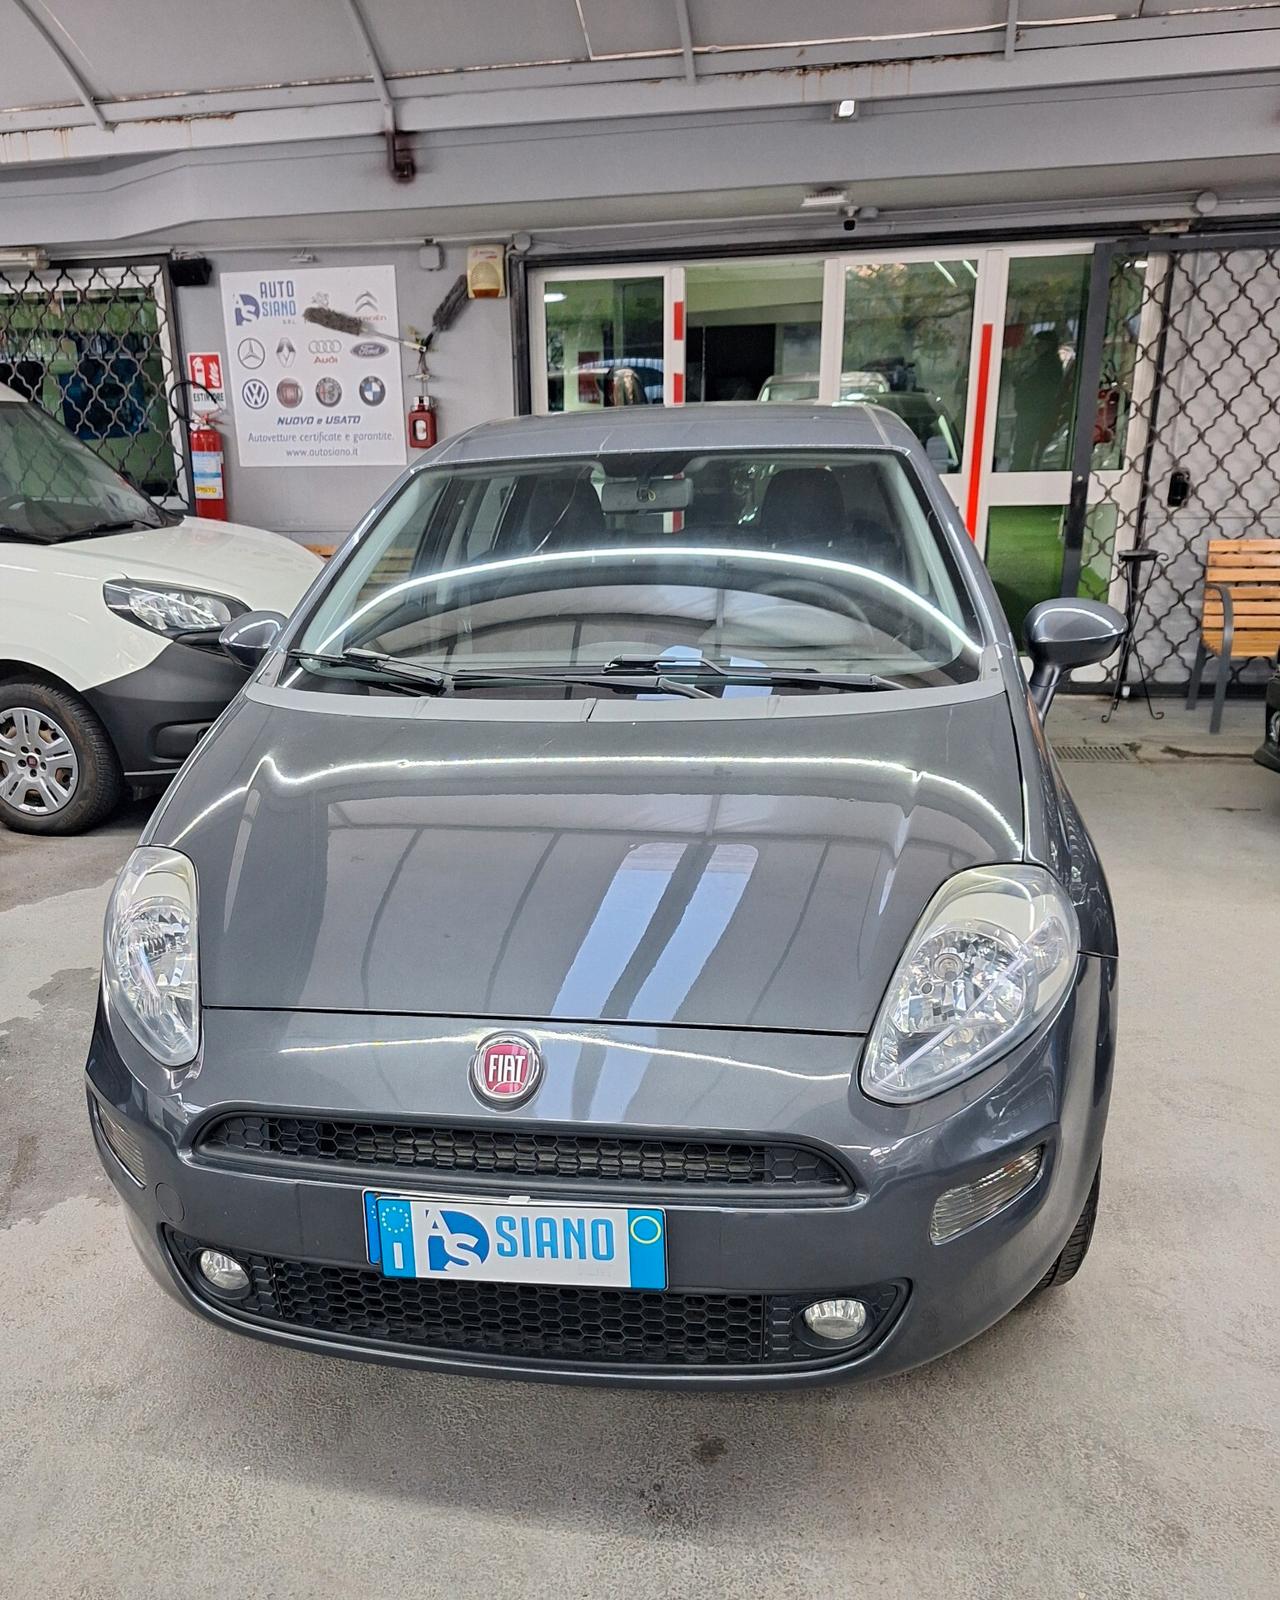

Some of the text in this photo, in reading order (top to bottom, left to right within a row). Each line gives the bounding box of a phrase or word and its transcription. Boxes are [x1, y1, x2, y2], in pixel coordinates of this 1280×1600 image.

[260, 280, 294, 298] AUTO
[261, 300, 297, 317] SIANO
[313, 356, 338, 364] Audi
[277, 416, 314, 426] NUOVO
[325, 415, 361, 425] USATO
[248, 432, 297, 442] Autovetture
[299, 431, 342, 443] certificate
[286, 447, 359, 457] www.autosiano.it
[488, 1054, 526, 1082] FIAT
[495, 1215, 614, 1261] SIANO
